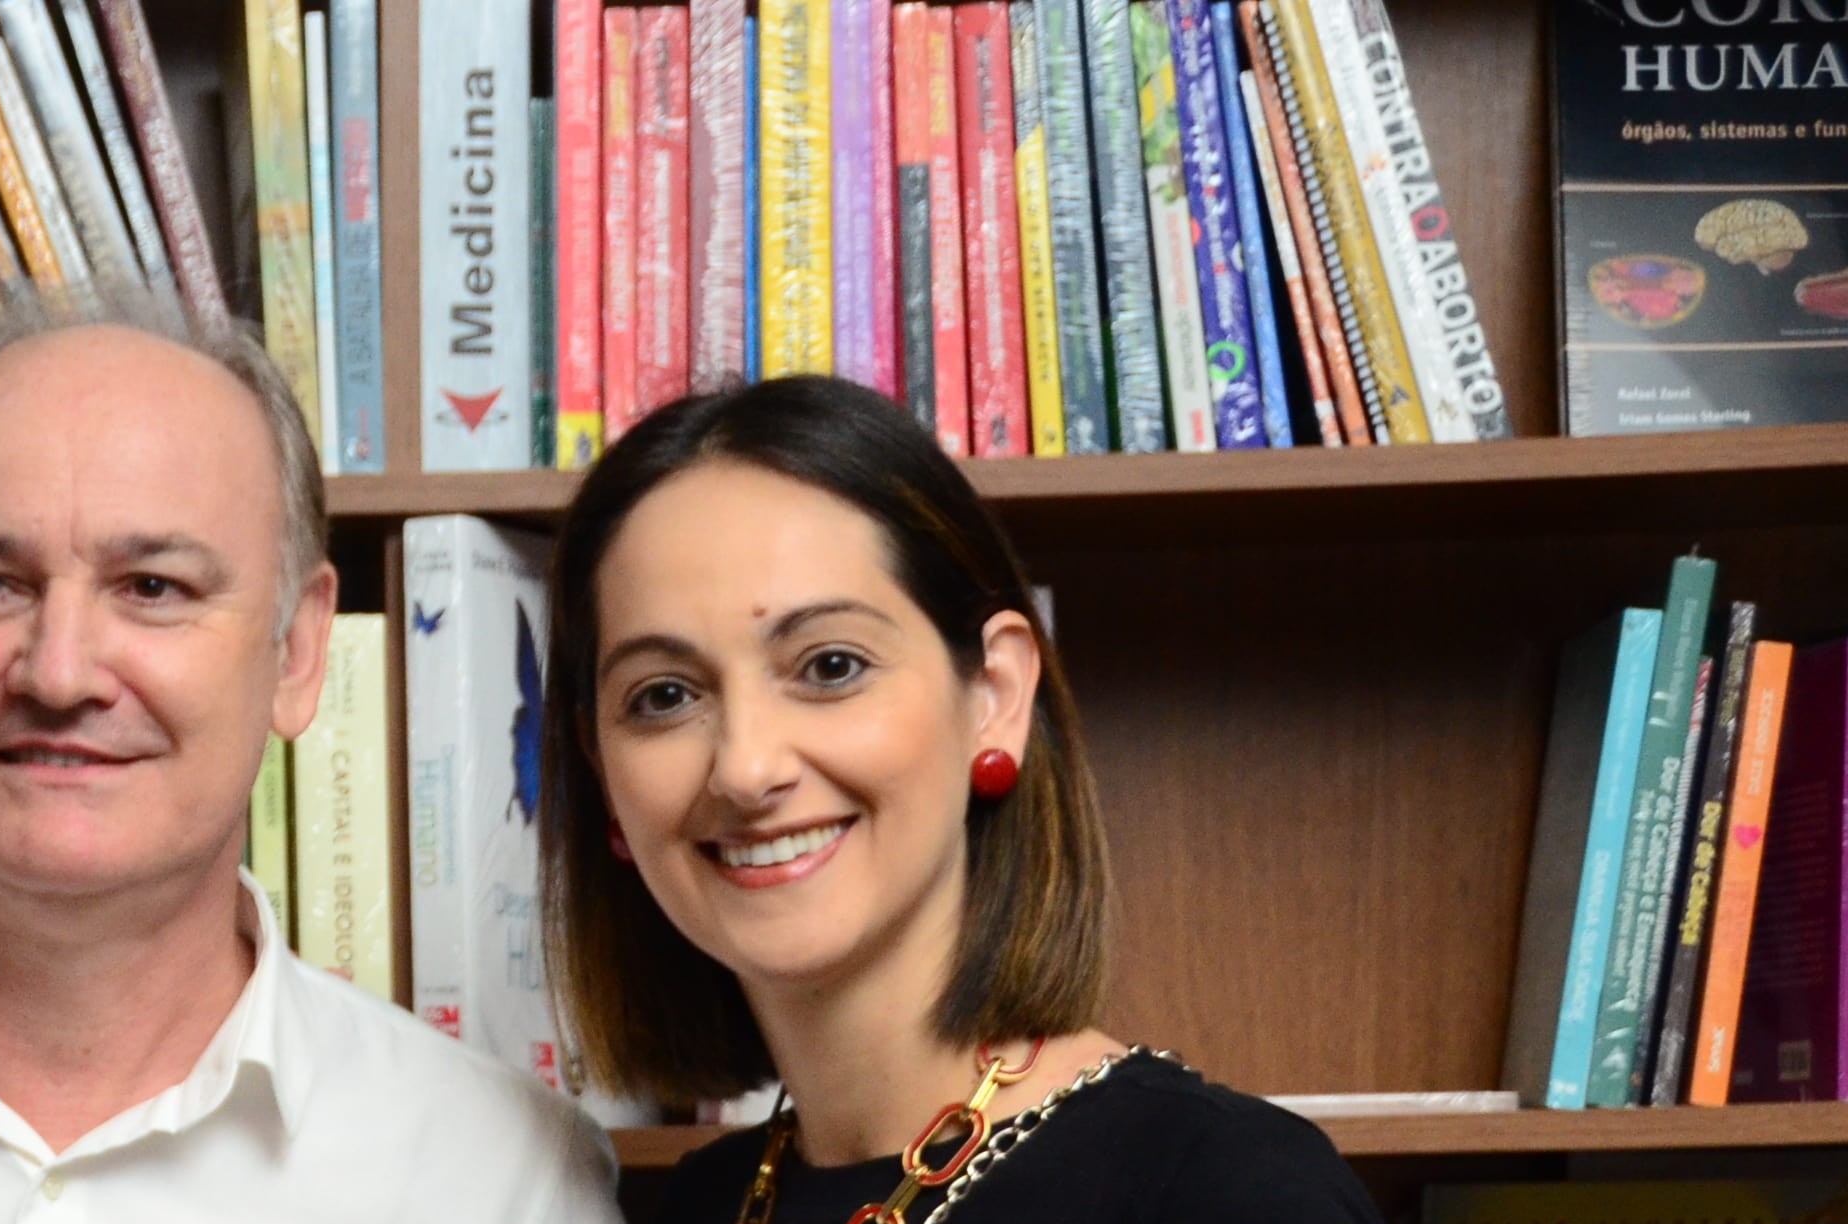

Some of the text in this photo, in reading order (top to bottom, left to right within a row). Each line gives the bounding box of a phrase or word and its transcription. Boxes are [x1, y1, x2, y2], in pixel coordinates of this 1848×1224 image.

[1621, 42, 1848, 91] HUMA
[1622, 120, 1692, 144] órgãos,
[1700, 120, 1788, 139] sistemas
[1795, 124, 1807, 139] e
[450, 68, 493, 357] Medicina
[329, 749, 354, 844] CAPITAL
[1658, 755, 1680, 795] Dor
[412, 760, 442, 888] Humano
[1652, 797, 1671, 820] de
[332, 853, 354, 868] E
[1639, 822, 1668, 893] Cabeça
[1678, 799, 1723, 947] Dor de Cabeça
